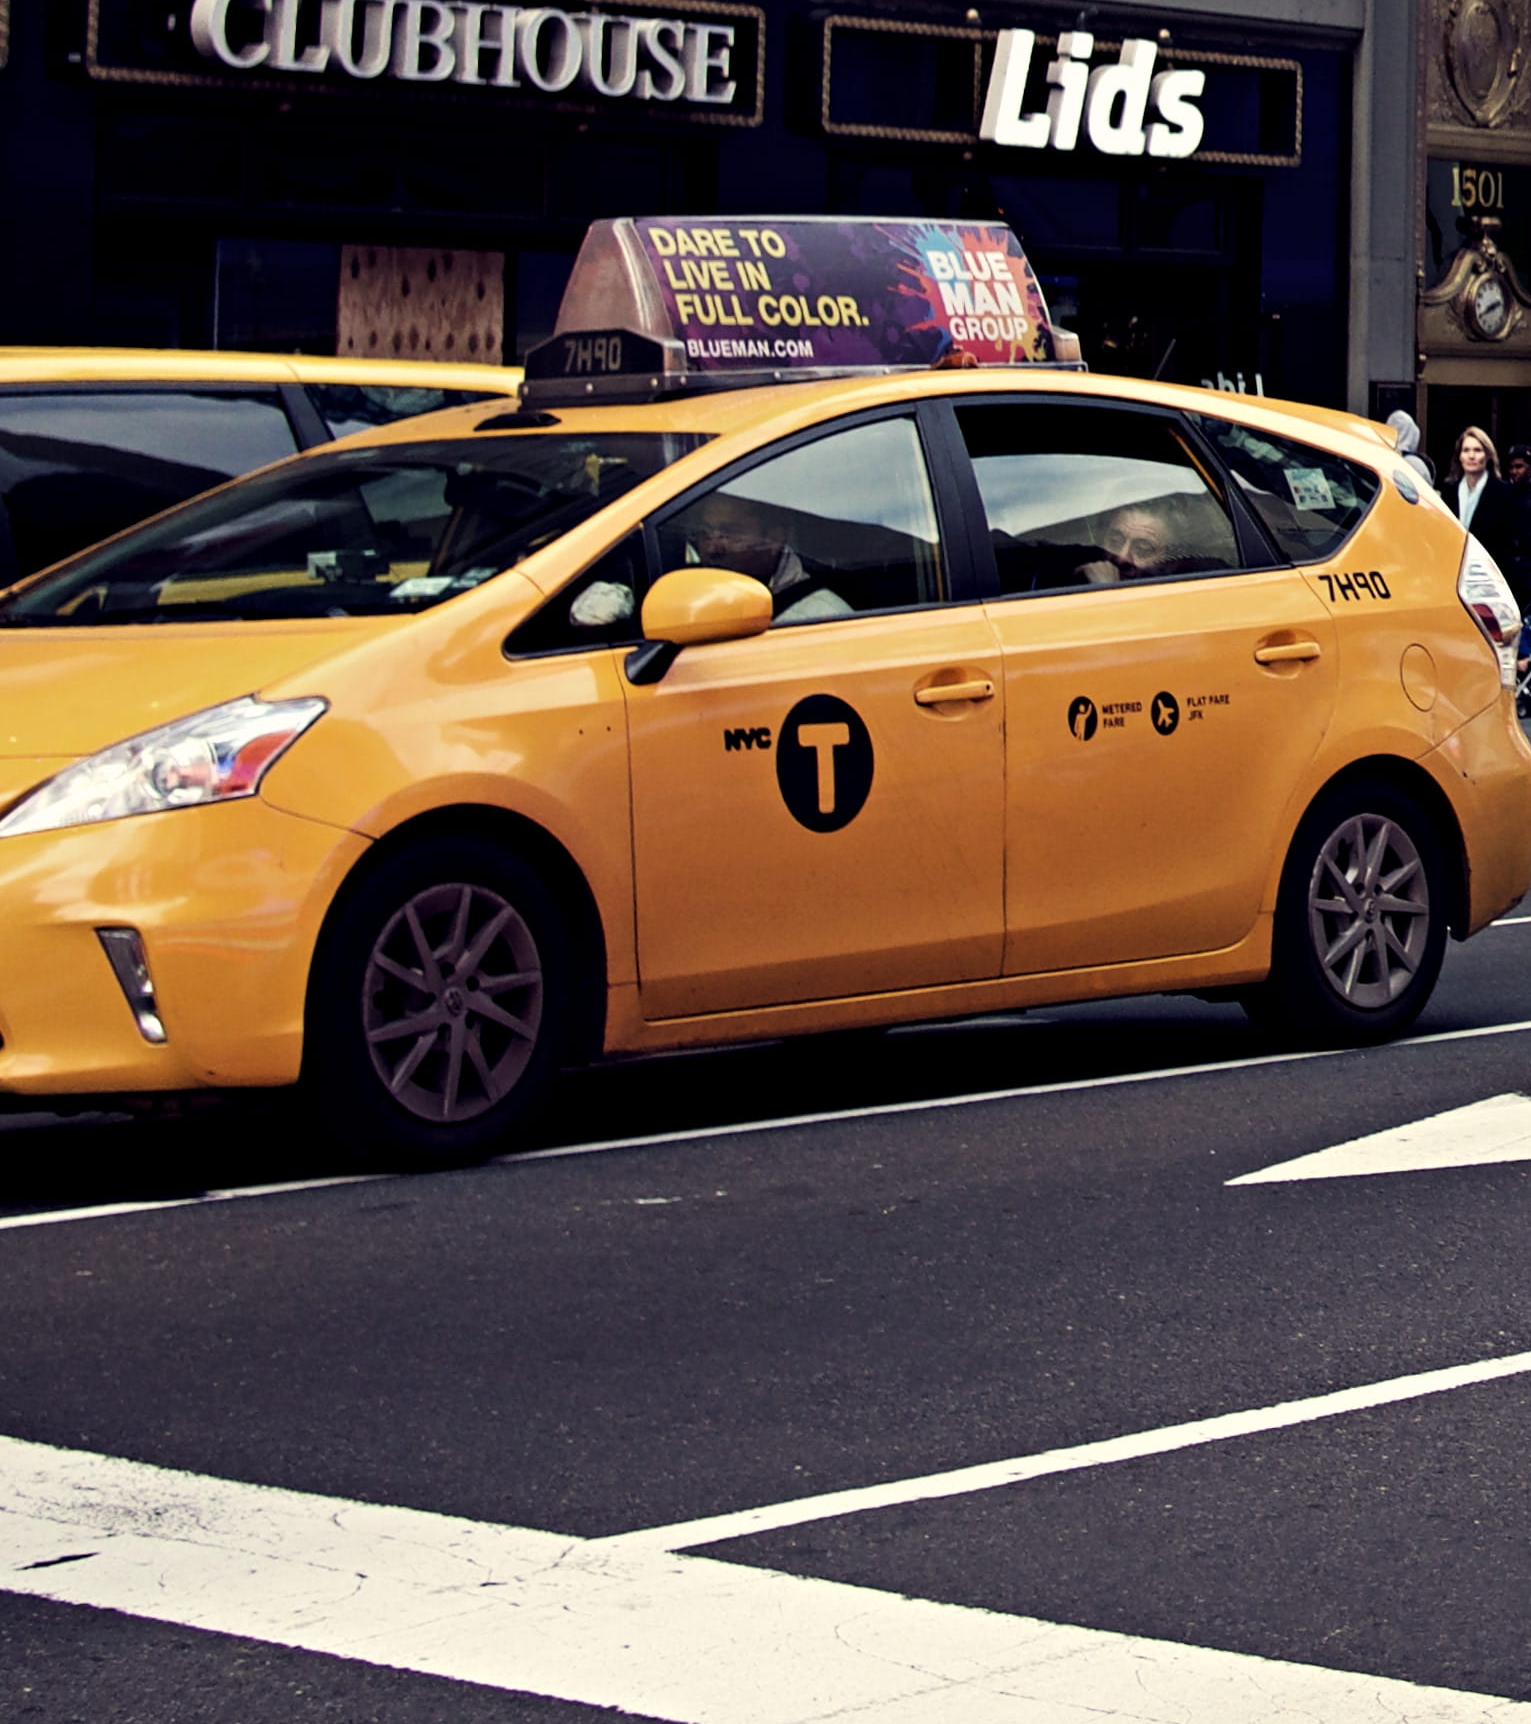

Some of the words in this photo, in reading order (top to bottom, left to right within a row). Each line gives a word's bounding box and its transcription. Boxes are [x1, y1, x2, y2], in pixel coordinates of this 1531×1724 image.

[979, 28, 1206, 159] Lids
[1451, 165, 1505, 208] 1501
[649, 227, 739, 259] DARE
[741, 229, 787, 259] TO
[665, 259, 737, 291] LIVE
[741, 261, 772, 292] IN
[926, 251, 1012, 283] BLUE
[675, 293, 755, 327] FULL
[758, 294, 870, 327] COLOR.
[938, 282, 1025, 317] MAN
[949, 316, 1030, 342] GROUP
[564, 337, 623, 373] 7H90
[687, 338, 814, 359] BLUEMAN.COM
[1317, 571, 1391, 603] 7H90
[1102, 701, 1142, 715] METERED
[1186, 696, 1206, 708] FLAT
[1208, 694, 1231, 705] FARE
[1188, 709, 1204, 721] JFK
[1103, 717, 1125, 729] FARE
[724, 727, 772, 752] NYC
[798, 722, 850, 814] T
